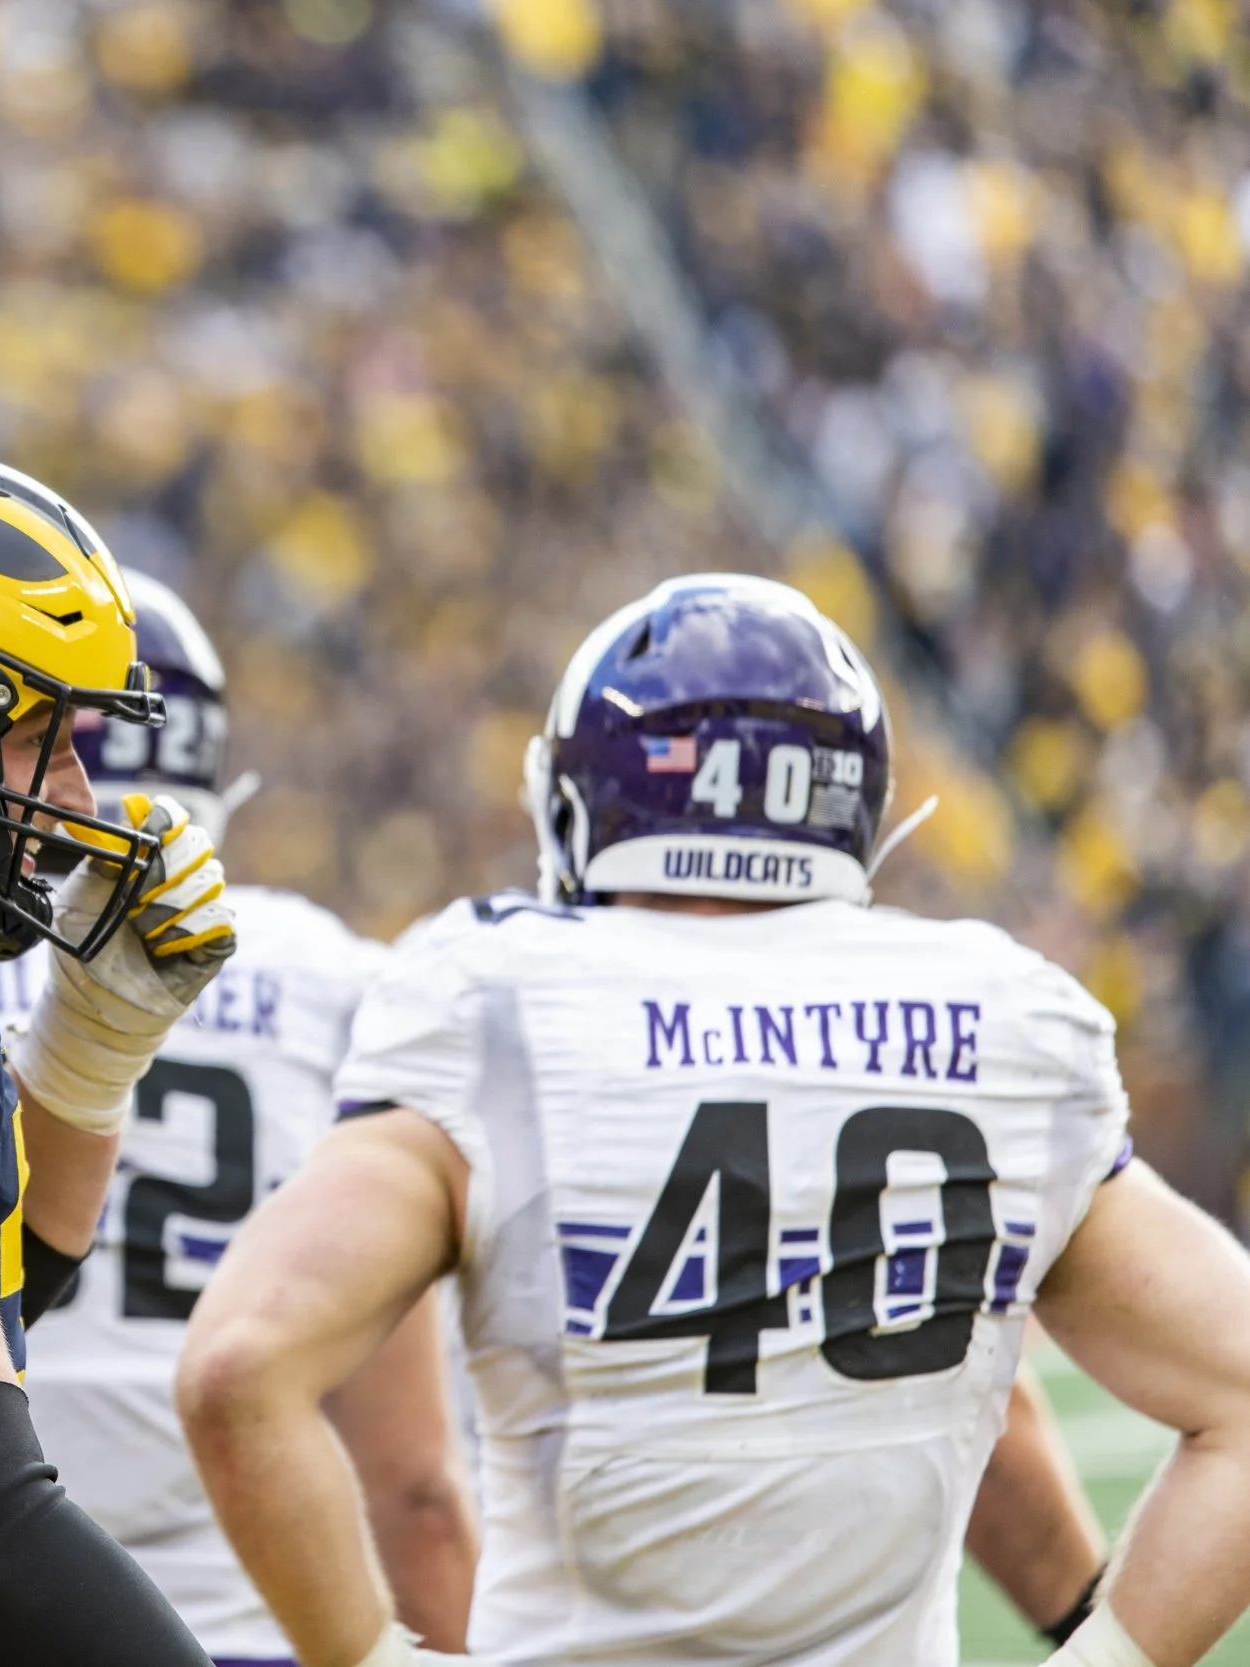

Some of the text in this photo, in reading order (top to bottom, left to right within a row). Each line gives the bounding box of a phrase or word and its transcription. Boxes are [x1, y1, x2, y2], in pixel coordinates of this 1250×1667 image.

[664, 848, 813, 888] WILDCATS
[643, 1000, 981, 1083] McINTYRE
[598, 1100, 999, 1396] 40
